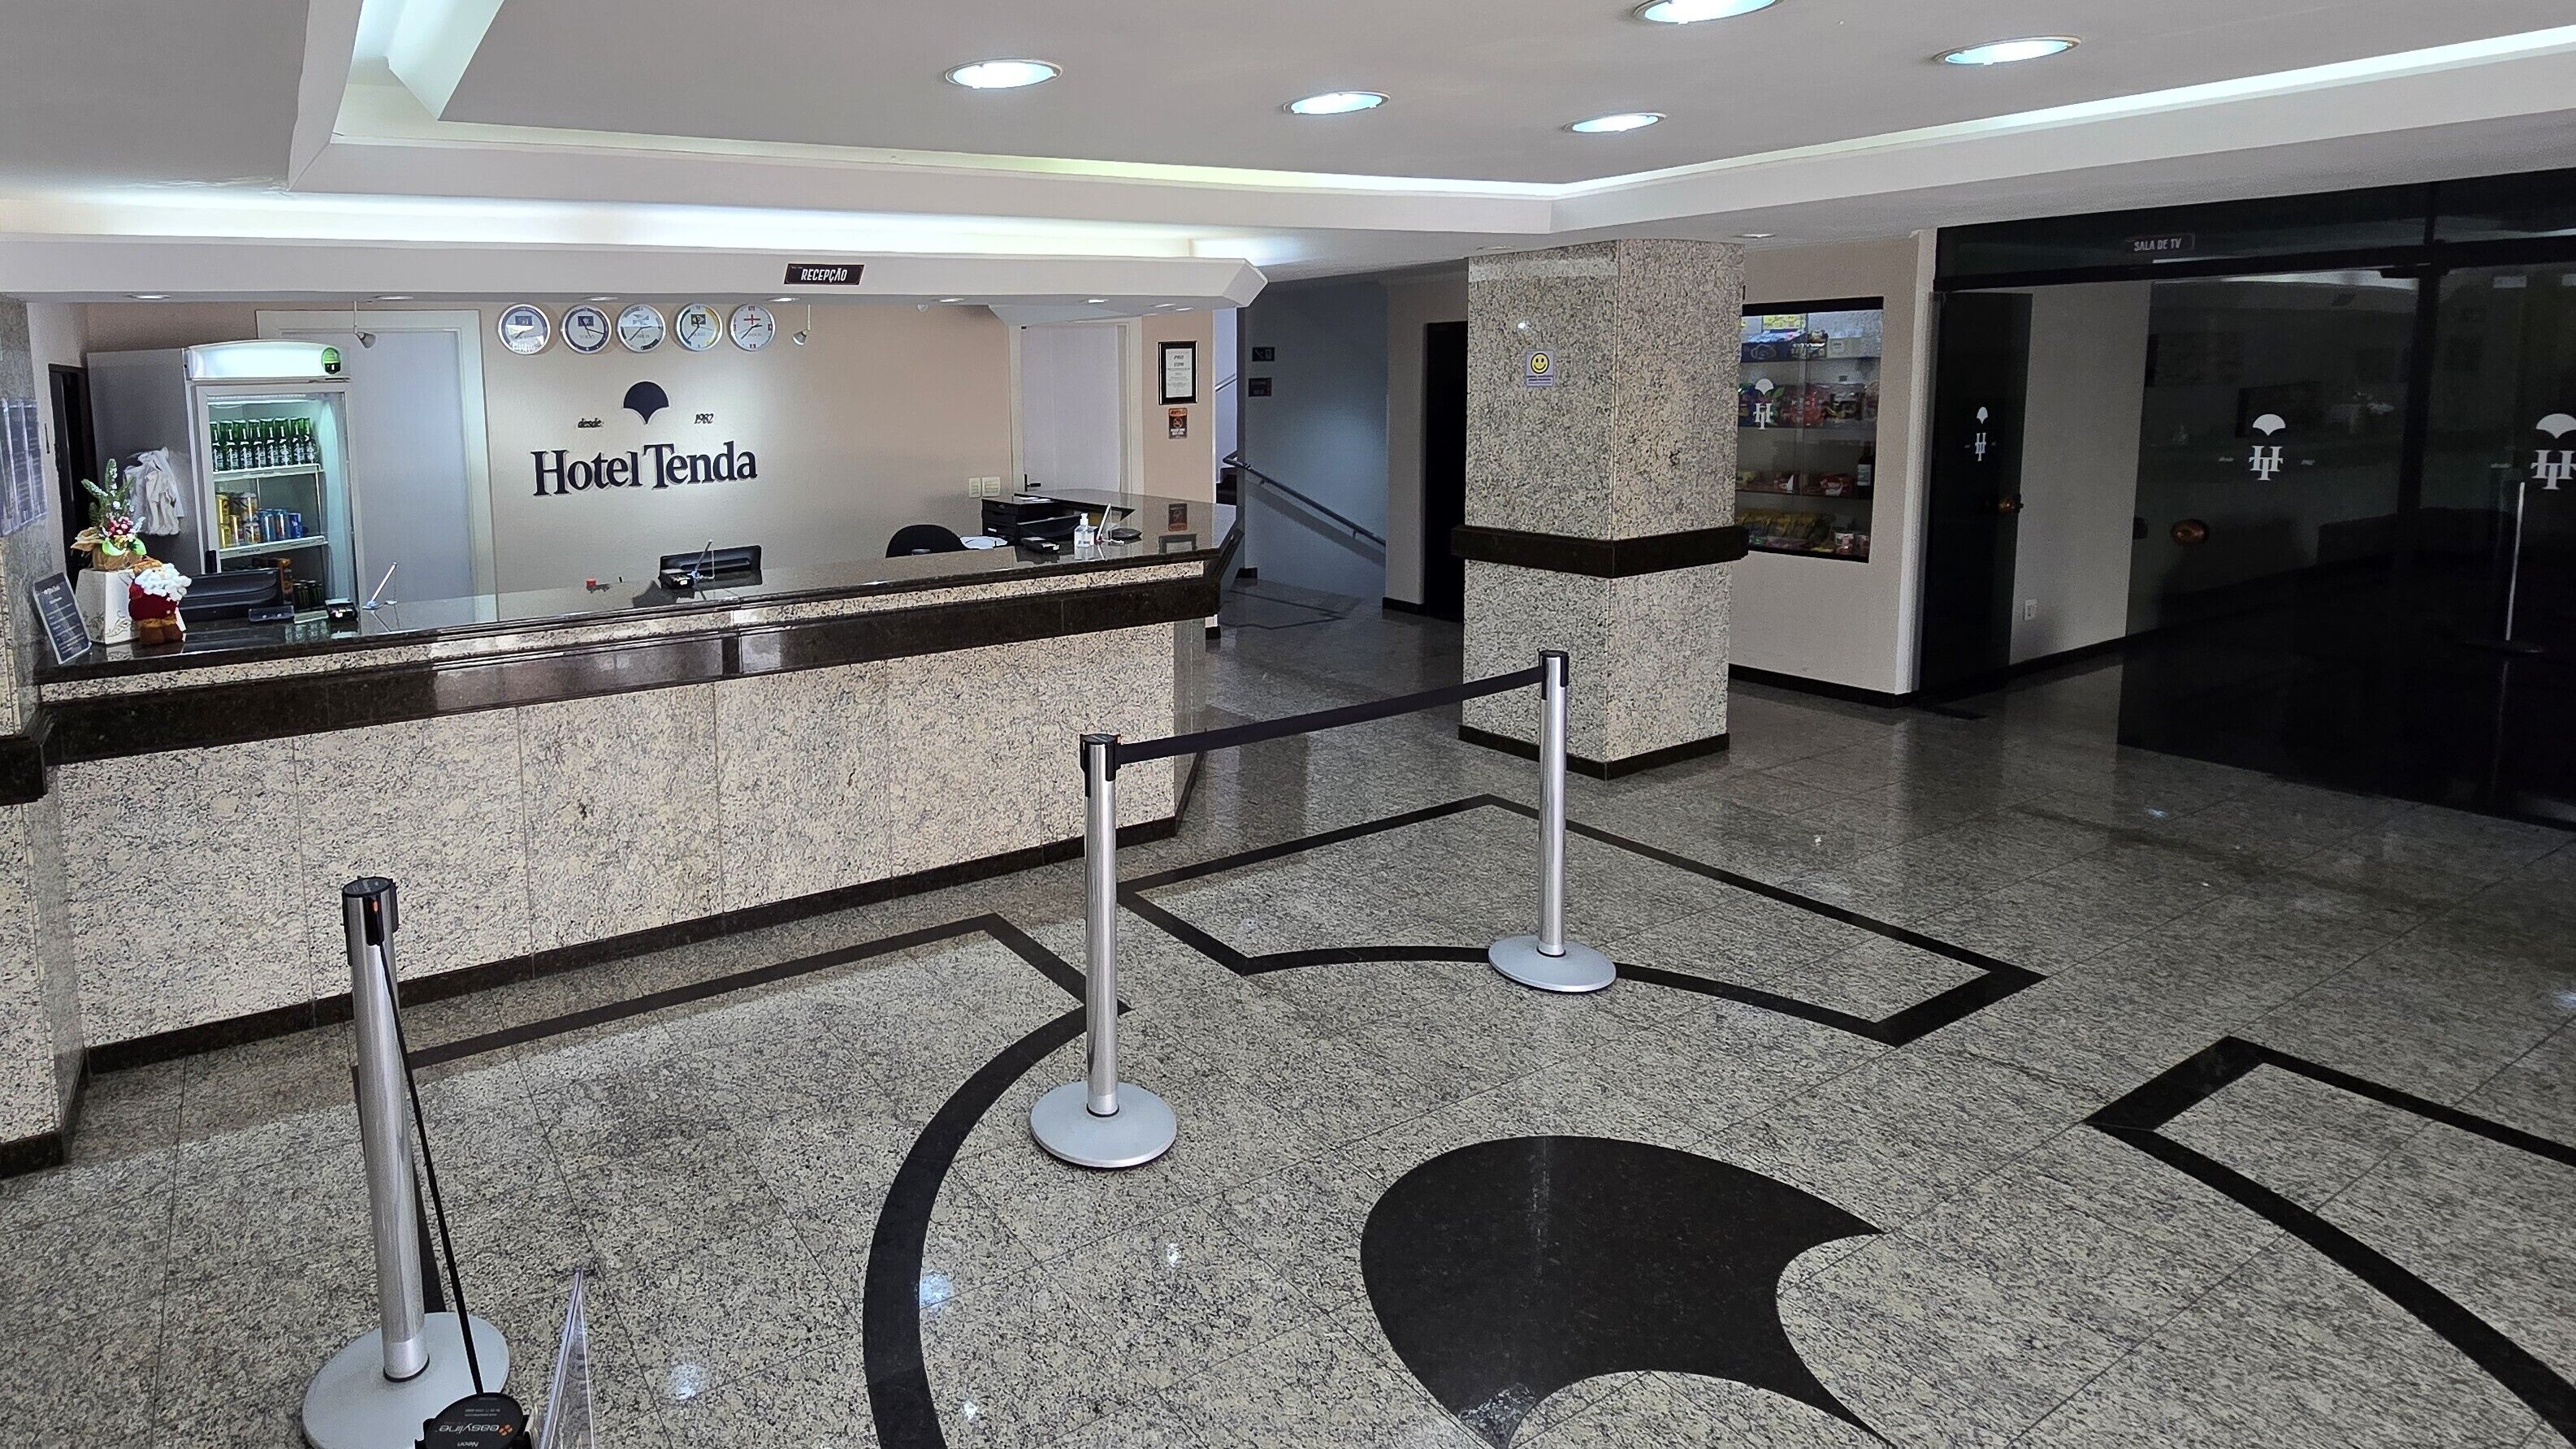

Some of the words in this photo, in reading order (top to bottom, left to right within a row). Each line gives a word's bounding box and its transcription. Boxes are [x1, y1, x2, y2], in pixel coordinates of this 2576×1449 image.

[2133, 240, 2155, 252] SALA
[2157, 239, 2168, 250] DE
[2171, 237, 2182, 249] TV
[800, 267, 848, 283] RECEPÇÃO
[694, 413, 714, 425] 1982
[530, 449, 643, 497] Hotel
[643, 440, 758, 491] Tenda
[439, 1422, 500, 1434] easyline
